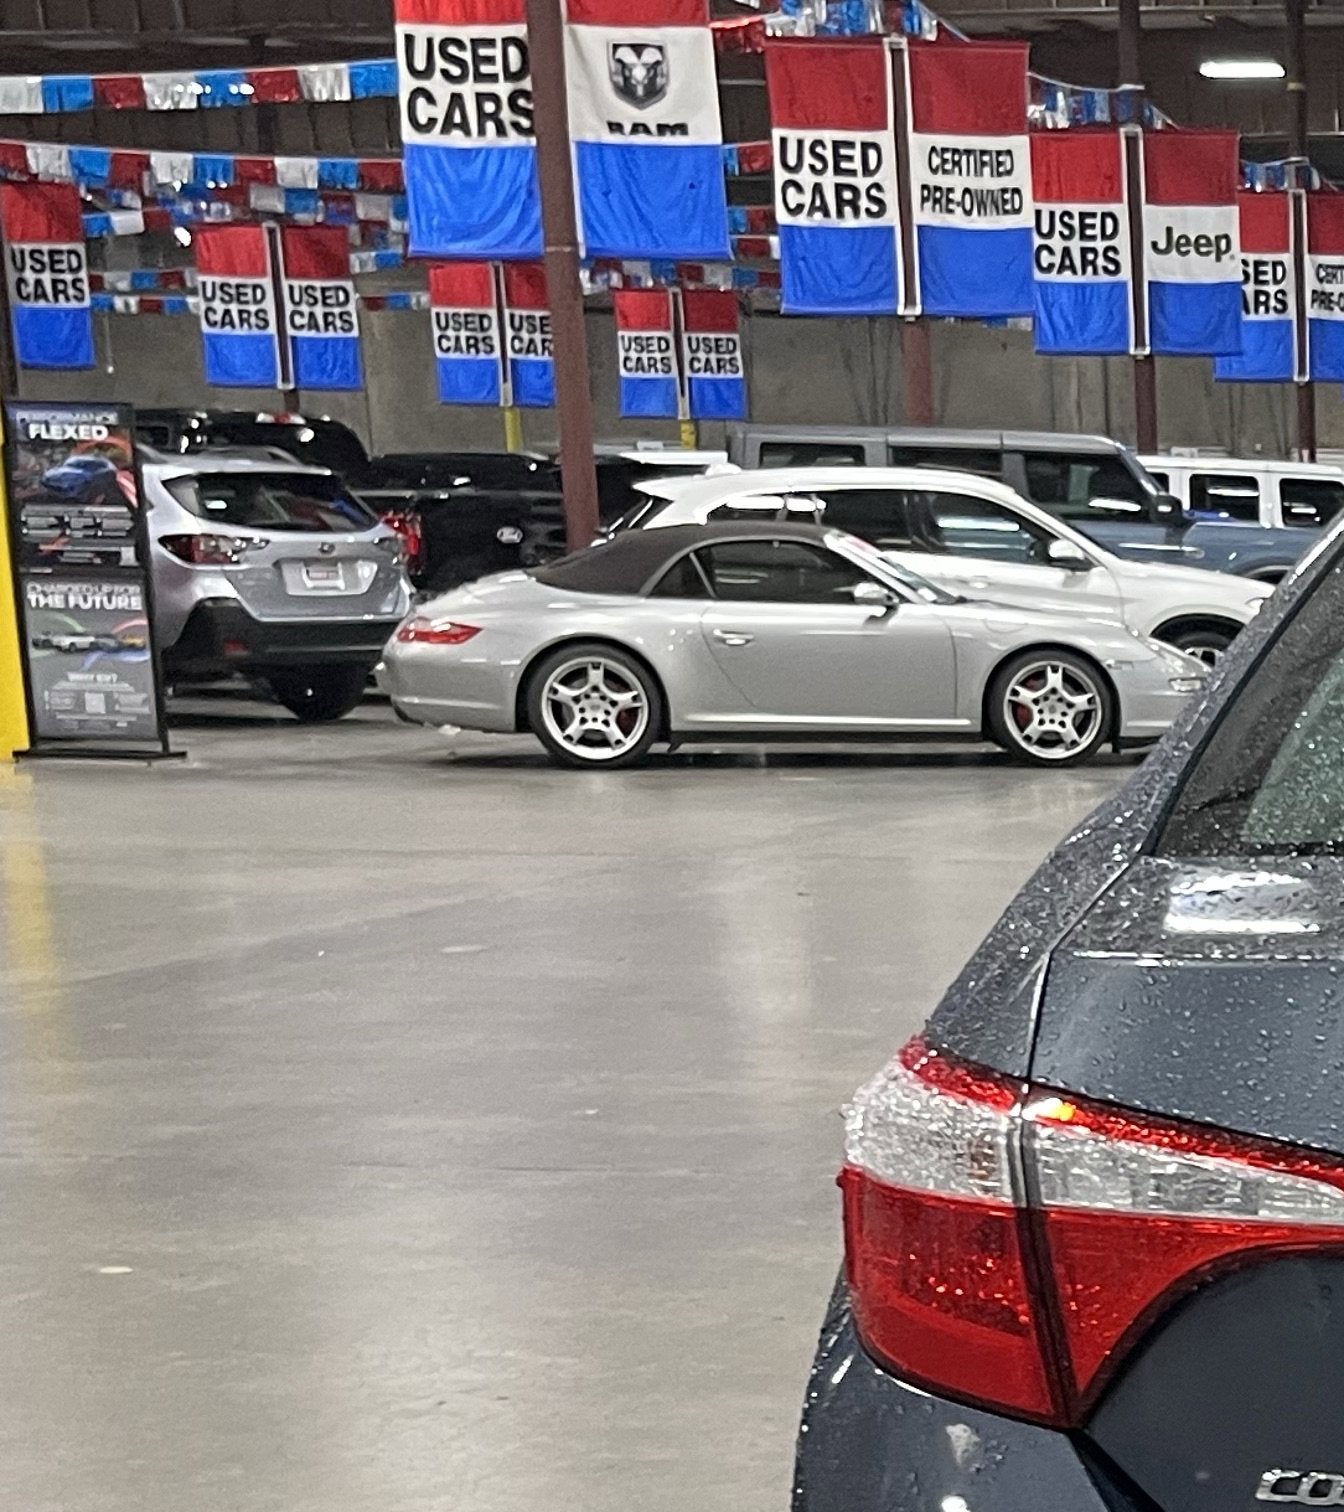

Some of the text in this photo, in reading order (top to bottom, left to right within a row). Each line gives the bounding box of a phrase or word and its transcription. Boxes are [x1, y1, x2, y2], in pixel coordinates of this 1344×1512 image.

[404, 34, 530, 84] USED
[408, 87, 534, 137] CARS
[606, 120, 688, 137] RAM
[780, 137, 883, 177] USED
[928, 146, 1014, 176] CERTIFIED
[781, 180, 887, 219] CARS
[920, 185, 1023, 217] PRE-OWNED
[1035, 209, 1119, 241] USED
[1151, 226, 1231, 261] Jeep
[11, 247, 83, 274] USED
[1035, 243, 1121, 276] CARS
[1241, 259, 1287, 285] SED
[16, 276, 85, 303] CARS
[202, 282, 267, 306] USED
[289, 284, 349, 307] USED
[1242, 289, 1289, 315] ARS
[204, 307, 270, 330] CARS
[290, 309, 354, 333] CARS
[435, 311, 491, 333] USED
[511, 312, 551, 335] USE
[437, 333, 495, 355] CARS
[511, 336, 553, 357] CAR
[620, 335, 670, 354] USED
[688, 336, 736, 354] USED
[622, 356, 672, 374] CARS
[689, 356, 740, 374] CARS
[29, 423, 109, 441] FLEXED
[27, 592, 142, 610] THE FUTURE
